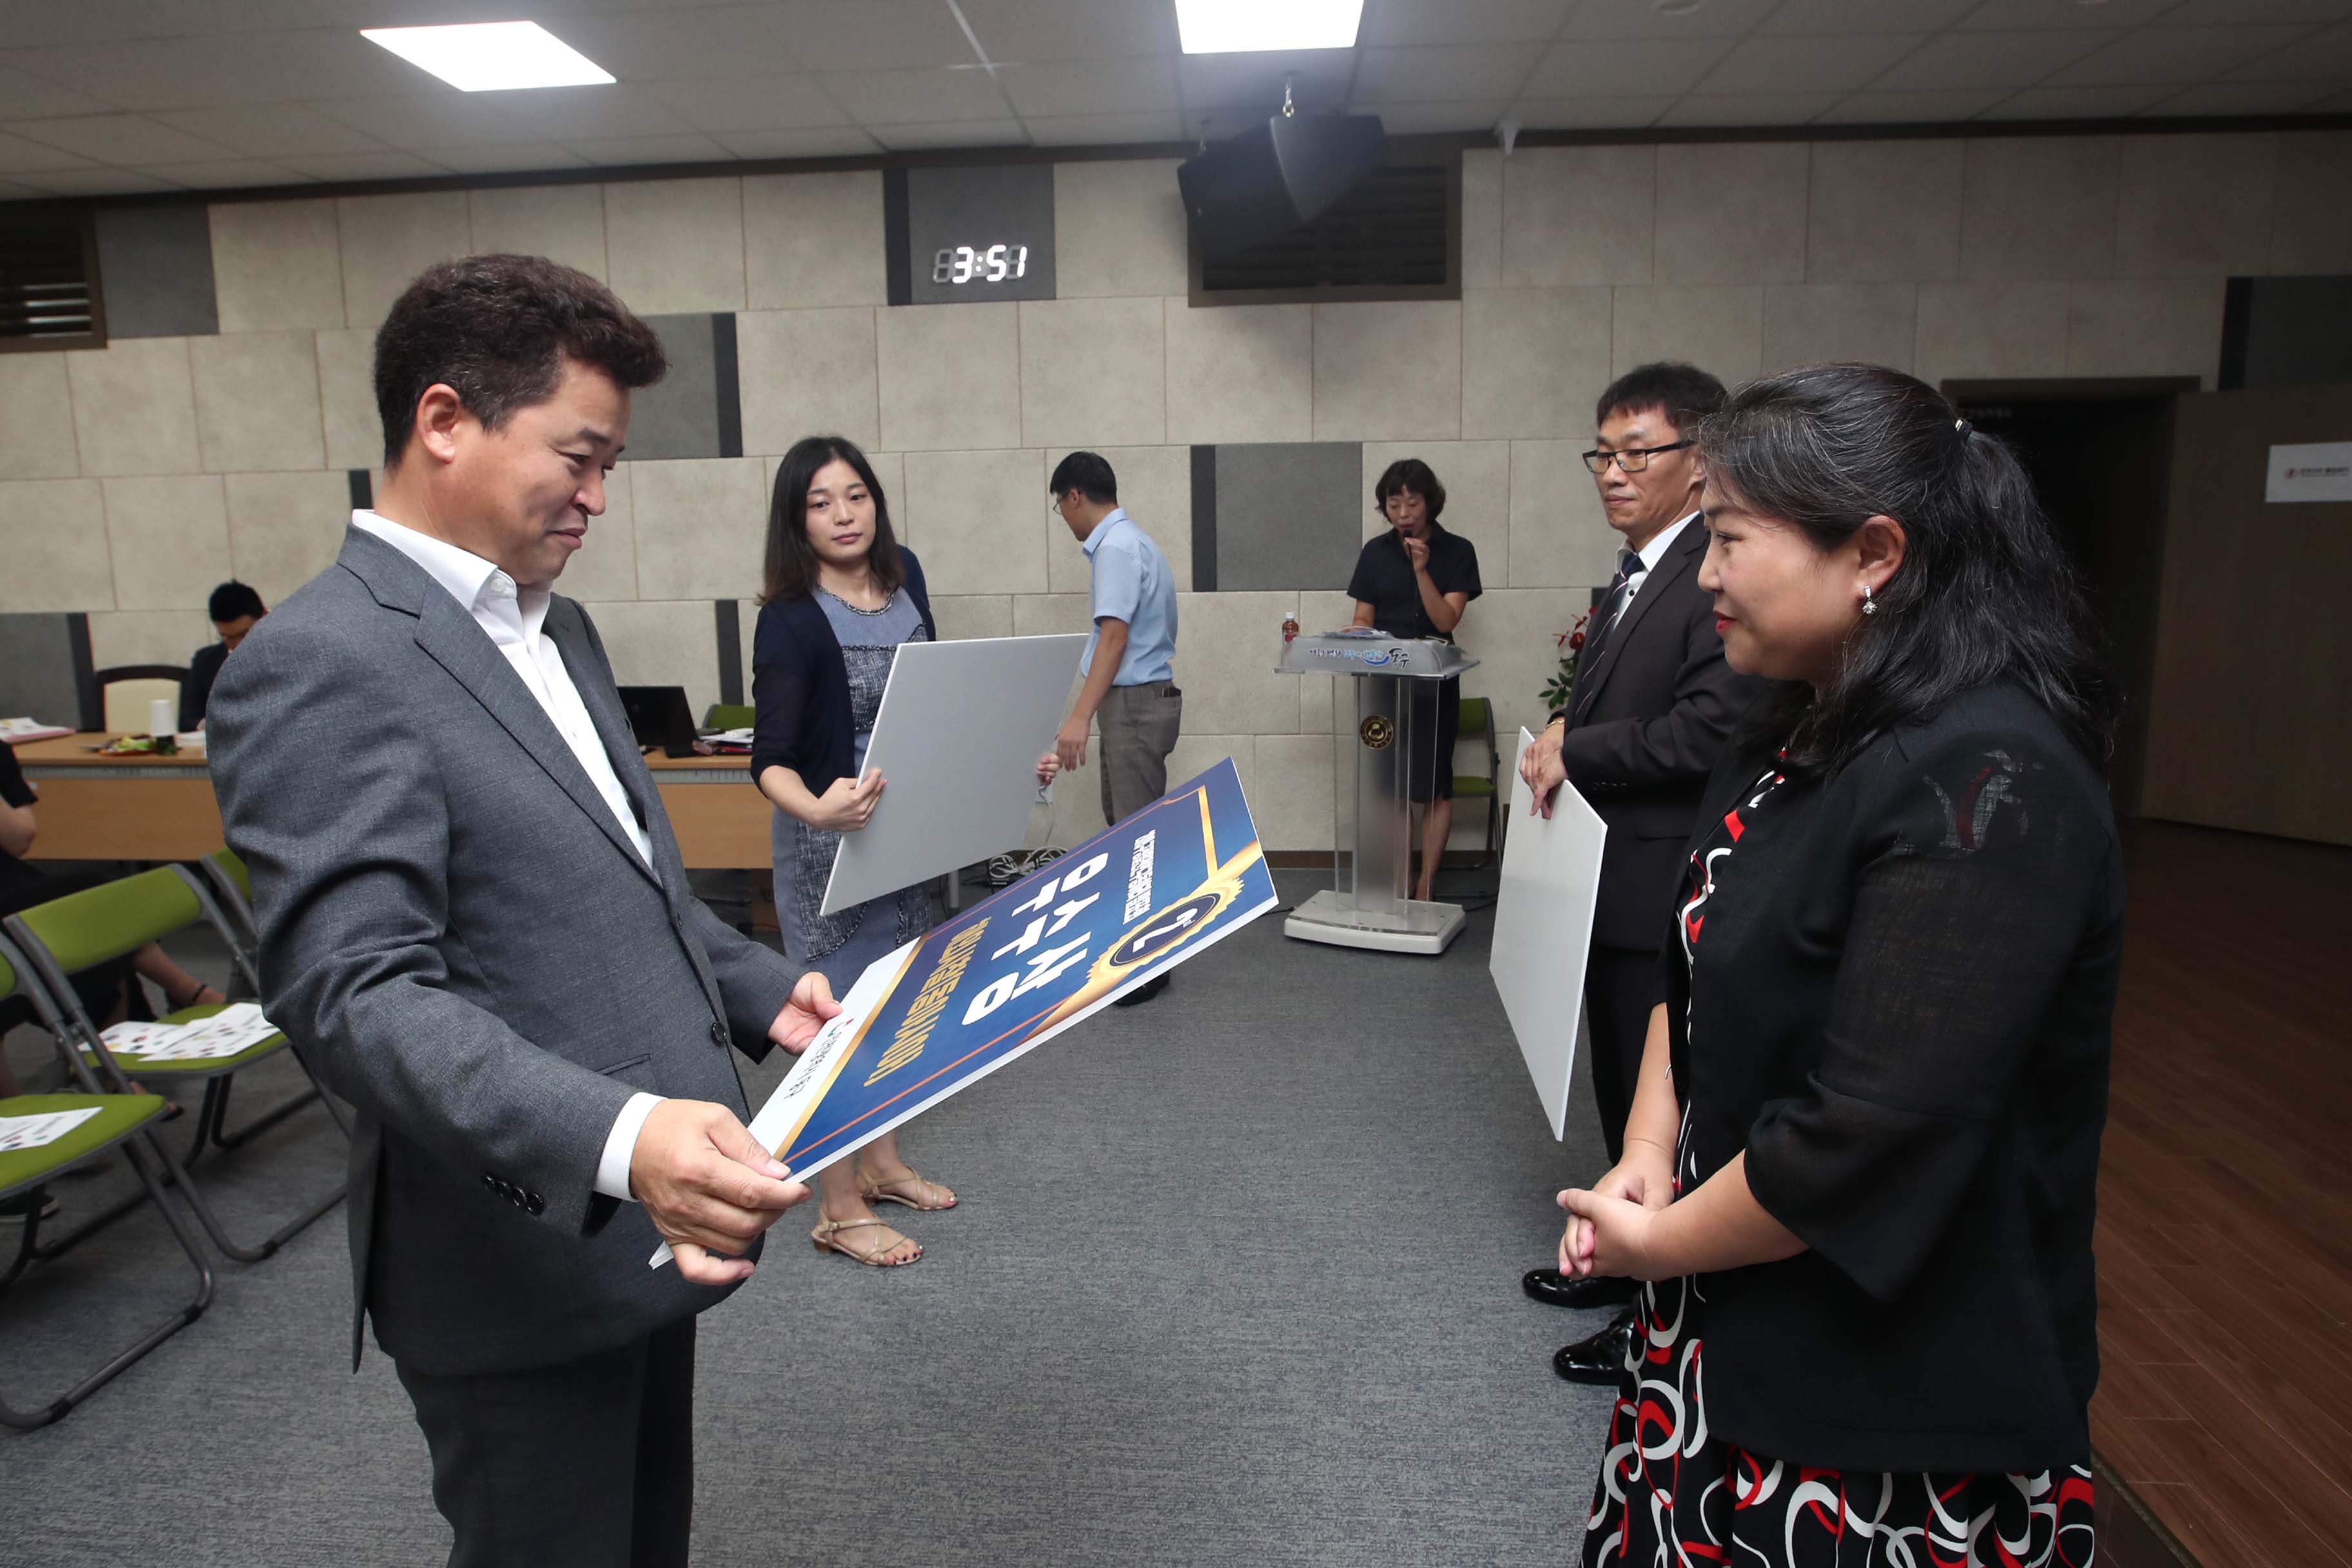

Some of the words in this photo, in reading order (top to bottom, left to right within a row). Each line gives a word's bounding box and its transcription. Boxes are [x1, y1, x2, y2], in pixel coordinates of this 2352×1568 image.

[952, 244, 1028, 284] 3:51
[961, 852, 1109, 1026] 우수상
[797, 1032, 842, 1081] 인천광역시
